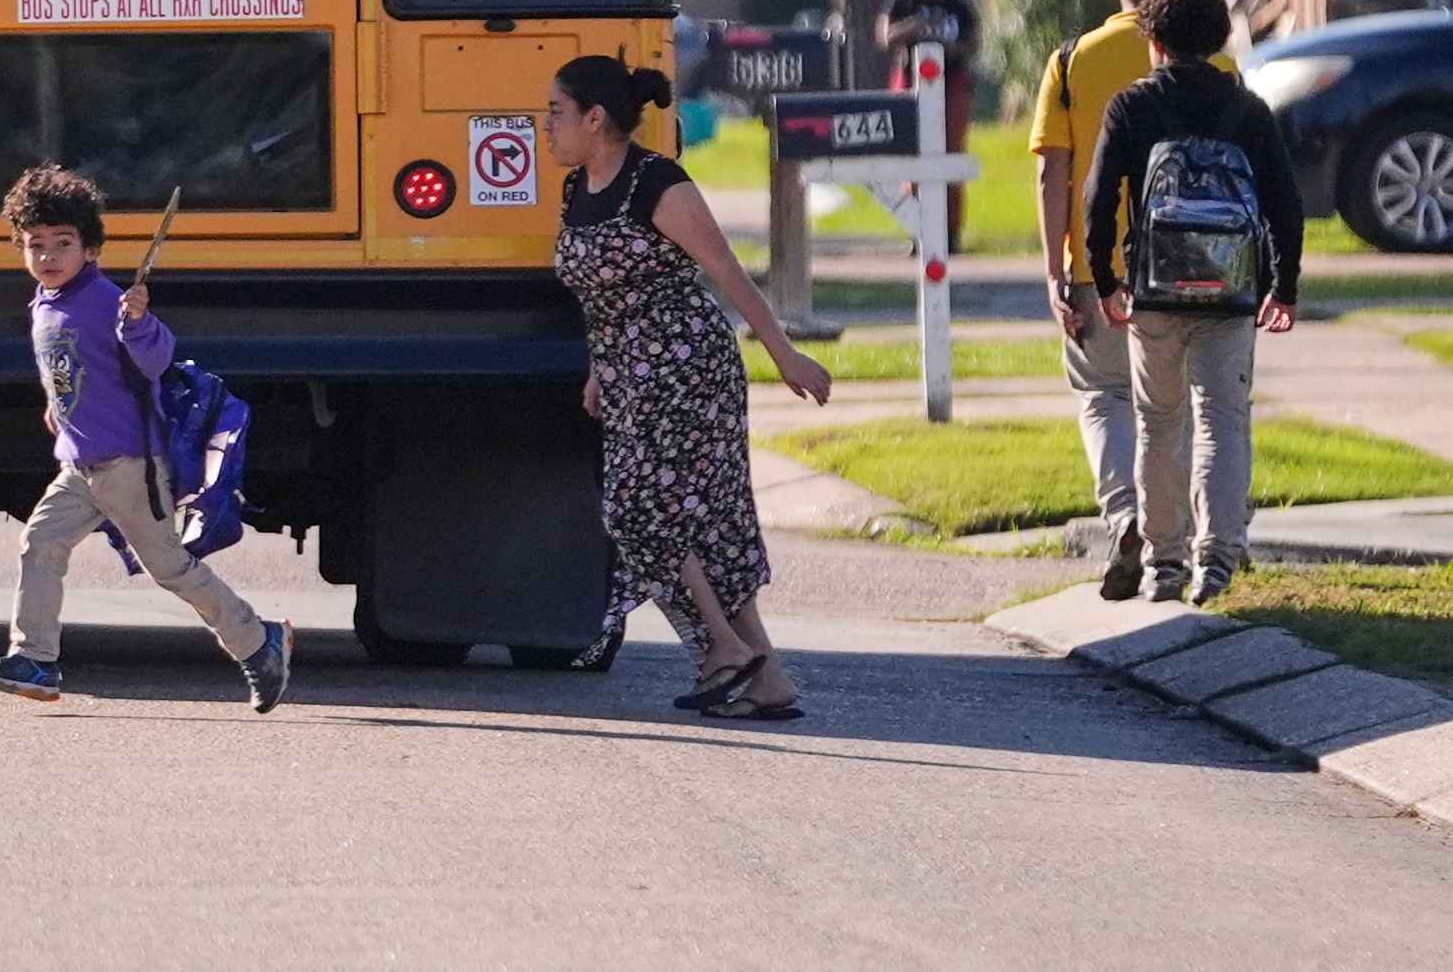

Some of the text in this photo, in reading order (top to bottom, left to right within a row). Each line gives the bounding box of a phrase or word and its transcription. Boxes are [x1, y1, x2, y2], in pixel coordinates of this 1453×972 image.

[473, 117, 534, 129] THIS BUS
[836, 111, 889, 143] 644
[478, 191, 529, 202] ON RED
